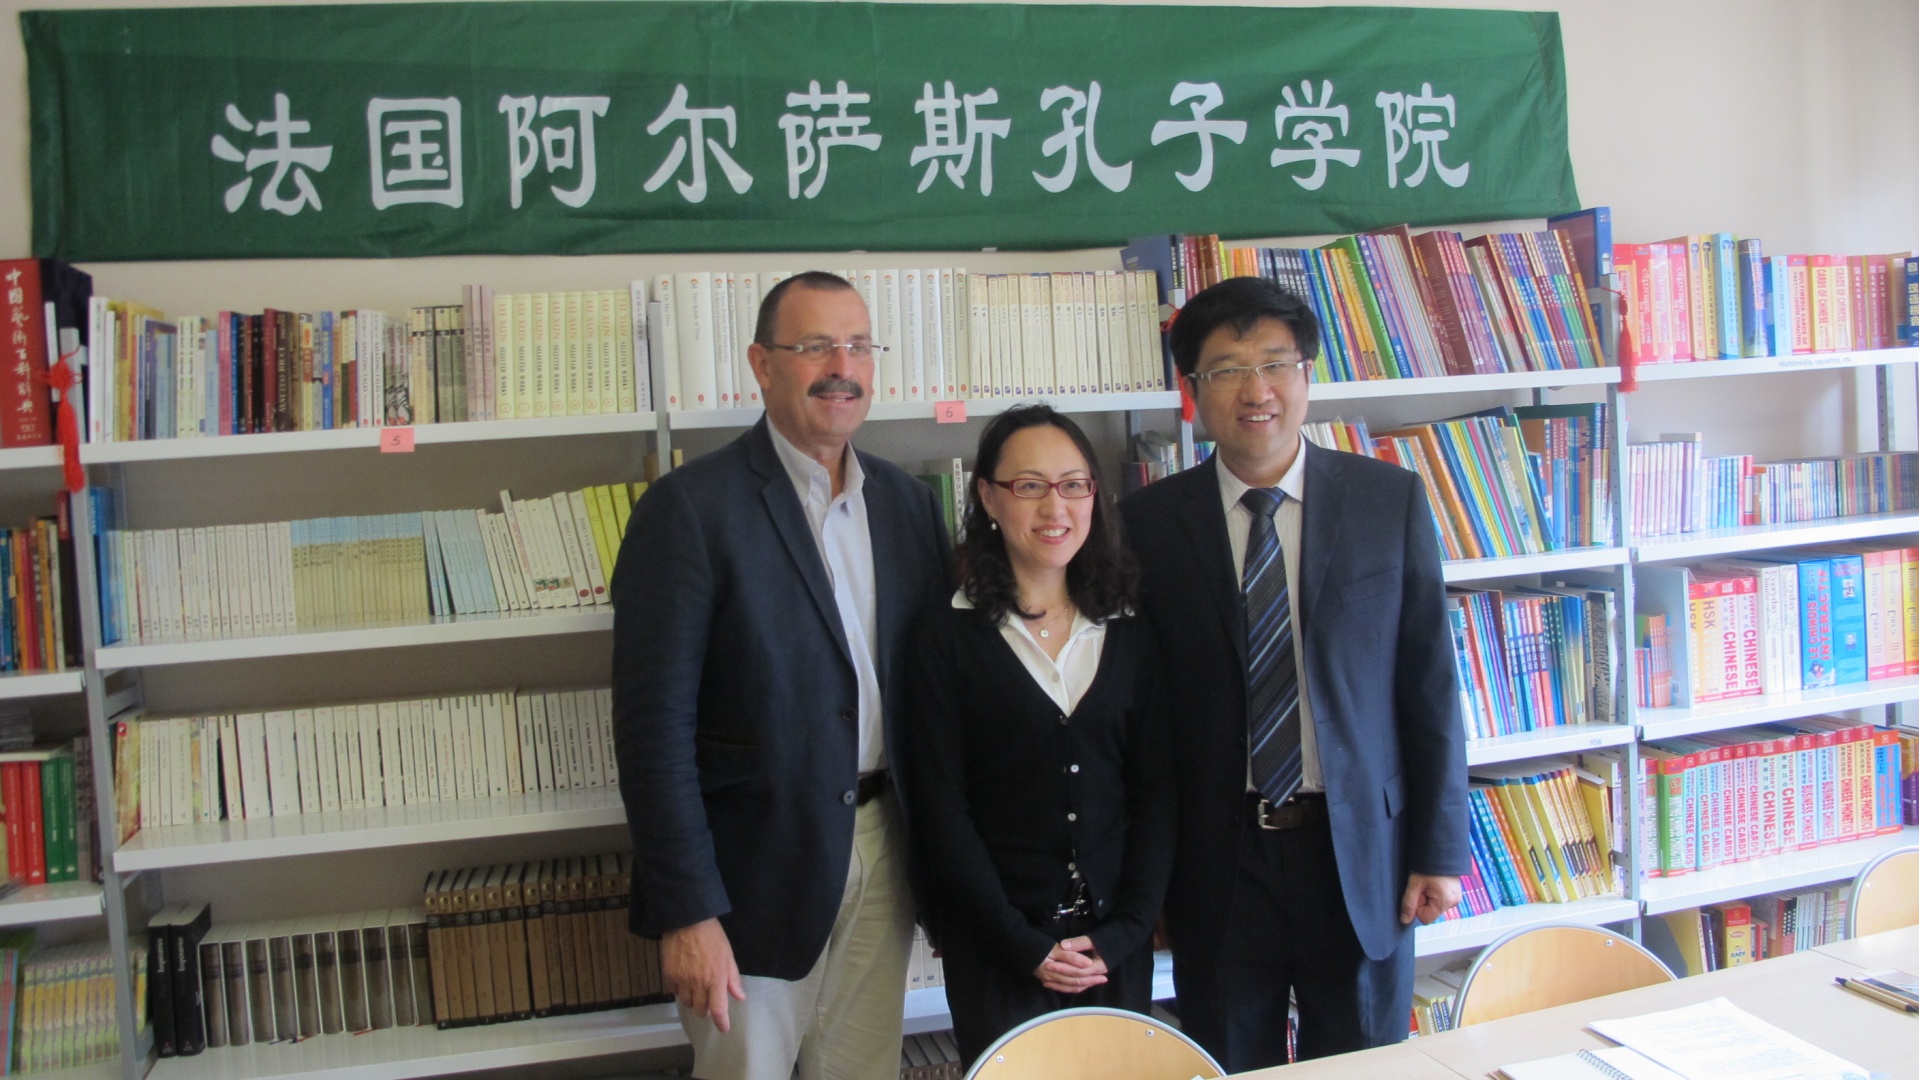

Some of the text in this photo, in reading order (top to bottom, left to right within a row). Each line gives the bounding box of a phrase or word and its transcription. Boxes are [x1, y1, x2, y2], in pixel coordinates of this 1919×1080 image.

[210, 79, 1471, 215] 法国阿尔萨斯孔子学院
[1816, 269, 1827, 289] CARDS
[1835, 267, 1845, 288] CARDS
[1817, 290, 1827, 298] OF
[1817, 299, 1829, 324] CHINESE
[1837, 297, 1847, 323] CHINESE
[1801, 337, 1807, 345] OF
[945, 406, 954, 418] 6
[390, 436, 401, 446] 5
[1769, 570, 1779, 615] Everyday
[1787, 567, 1796, 612] Everyday
[1703, 600, 1717, 629] HSK
[1817, 569, 1830, 660] INTERACTIF
[1807, 602, 1819, 659] LE CHINOIS
[1723, 631, 1738, 690] CHINESE
[1743, 630, 1758, 688] CHINESE
[1801, 785, 1814, 814] BUSINESS
[1821, 781, 1834, 811] BUSINESS
[1840, 778, 1853, 802] CHINESE
[1860, 775, 1872, 800] CHINESE
[1685, 797, 1695, 835] CHINESE
[1700, 794, 1710, 832] CHINESE
[1710, 792, 1720, 829] CHINESE
[1723, 789, 1732, 827] CHINESE
[1736, 787, 1746, 824] CHINESE
[1749, 785, 1758, 822] CHINESE
[1782, 787, 1795, 845] CHINESE
[1841, 802, 1854, 834] PHONETICS
[1861, 799, 1873, 831] PHONETICS
[1763, 790, 1776, 849] CHINESE
[1801, 815, 1815, 841] CHINESE
[1822, 811, 1834, 837] CHINESE
[1685, 837, 1694, 865] CARDS
[1701, 834, 1711, 863] CARDS
[1711, 831, 1720, 860] CARDS
[1723, 828, 1732, 857] CARDS
[1738, 826, 1747, 855] CARDS
[1750, 824, 1759, 853] CARDS
